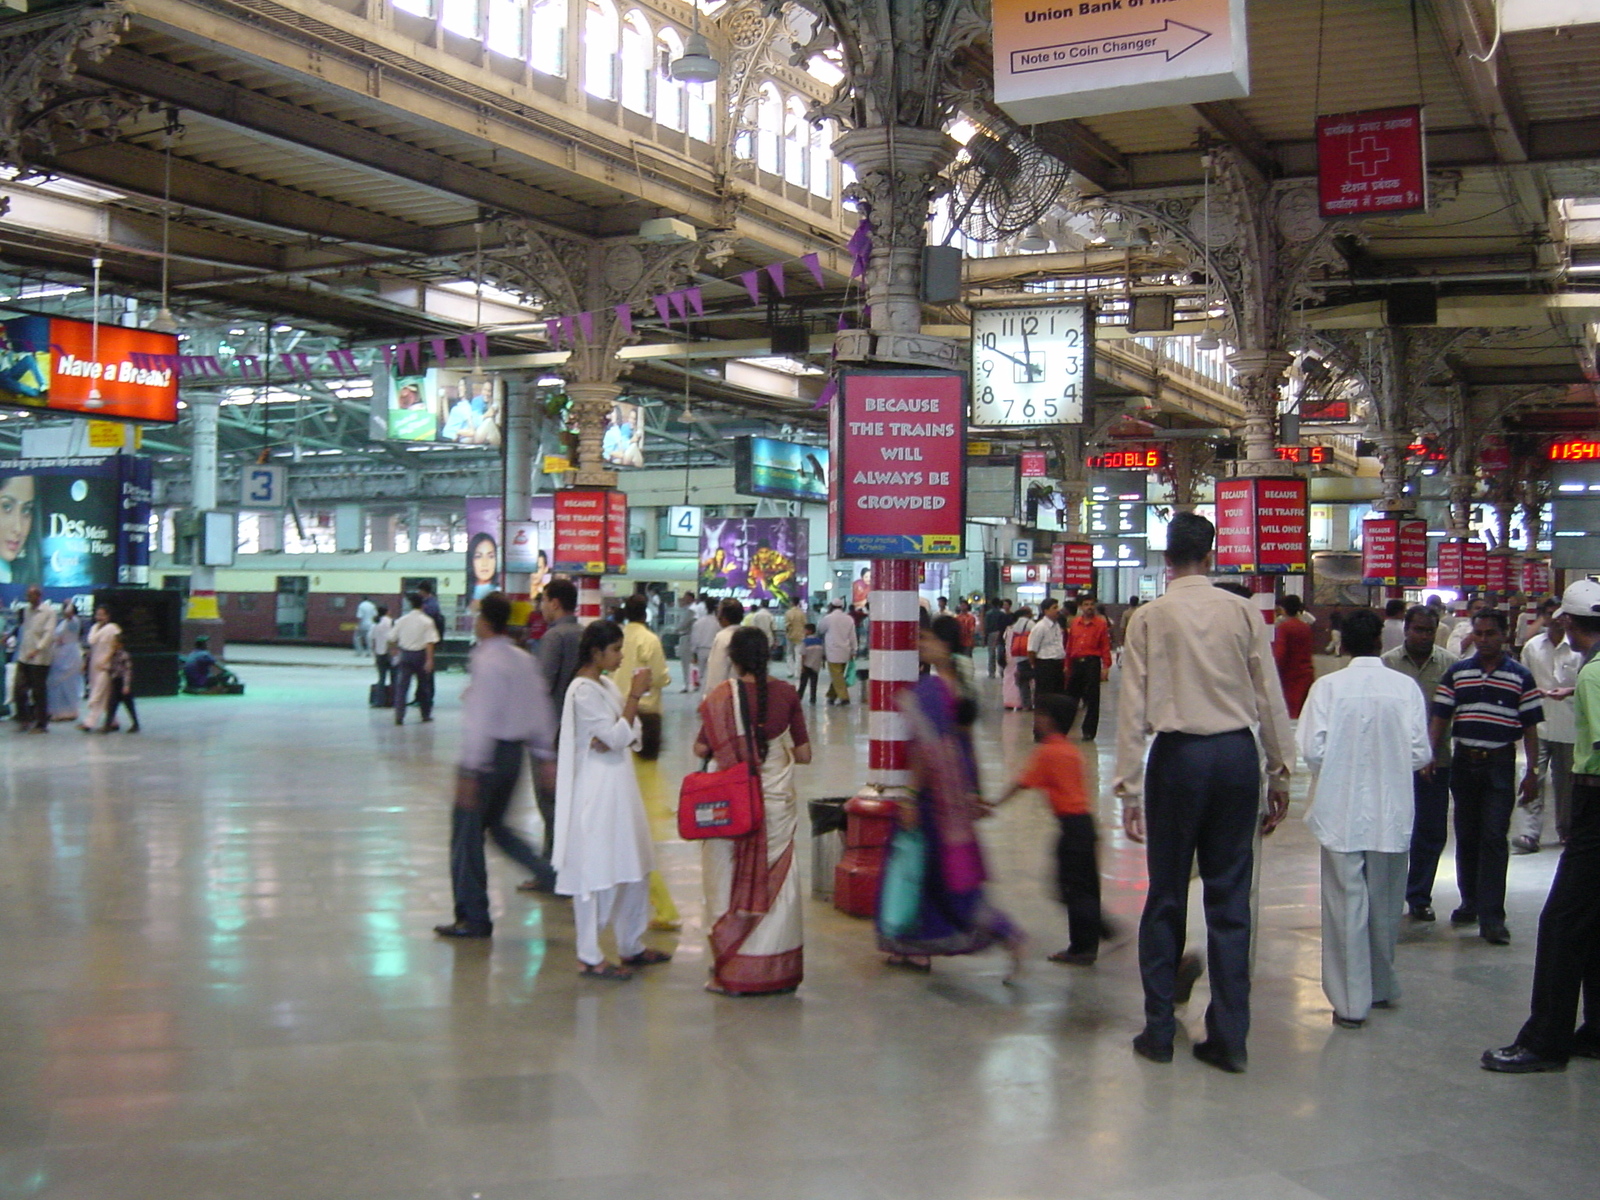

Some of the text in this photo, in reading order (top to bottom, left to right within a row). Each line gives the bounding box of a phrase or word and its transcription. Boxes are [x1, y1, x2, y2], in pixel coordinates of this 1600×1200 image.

[1025, 8, 1073, 23] Union
[1079, 0, 1122, 15] Bank
[1021, 37, 1157, 65] Note to Coin Changer
[1021, 316, 1038, 335] 12
[982, 332, 996, 350] 10
[1065, 329, 1079, 347] 2
[58, 354, 171, 387] Have a Break!
[982, 360, 994, 378] 9
[1066, 356, 1078, 375] 3
[982, 386, 994, 404] 8
[1063, 383, 1077, 403] 4
[865, 398, 939, 413] BECAUSE
[1003, 400, 1014, 418] 7
[1023, 399, 1035, 417] 6
[1044, 399, 1057, 417] 5
[849, 422, 954, 437] THE TRAINS
[881, 447, 922, 461] WILL
[251, 471, 272, 500] 3
[853, 471, 949, 485] ALWAYS BE
[857, 495, 945, 510] CROWDED
[1221, 490, 1247, 499] BECAUSE
[1265, 490, 1297, 499] BECAUSE
[1224, 508, 1243, 517] YOUR
[1258, 508, 1272, 516] THE
[1275, 508, 1304, 516] TRAFFIC
[50, 513, 86, 538] Des
[678, 511, 692, 532] 4
[1218, 526, 1250, 535] SURNAME
[1261, 525, 1302, 533] WILL ONLY
[1017, 542, 1028, 557] 6
[1217, 544, 1251, 553] ISN'T TATA
[1261, 543, 1302, 551] GET WORSE
